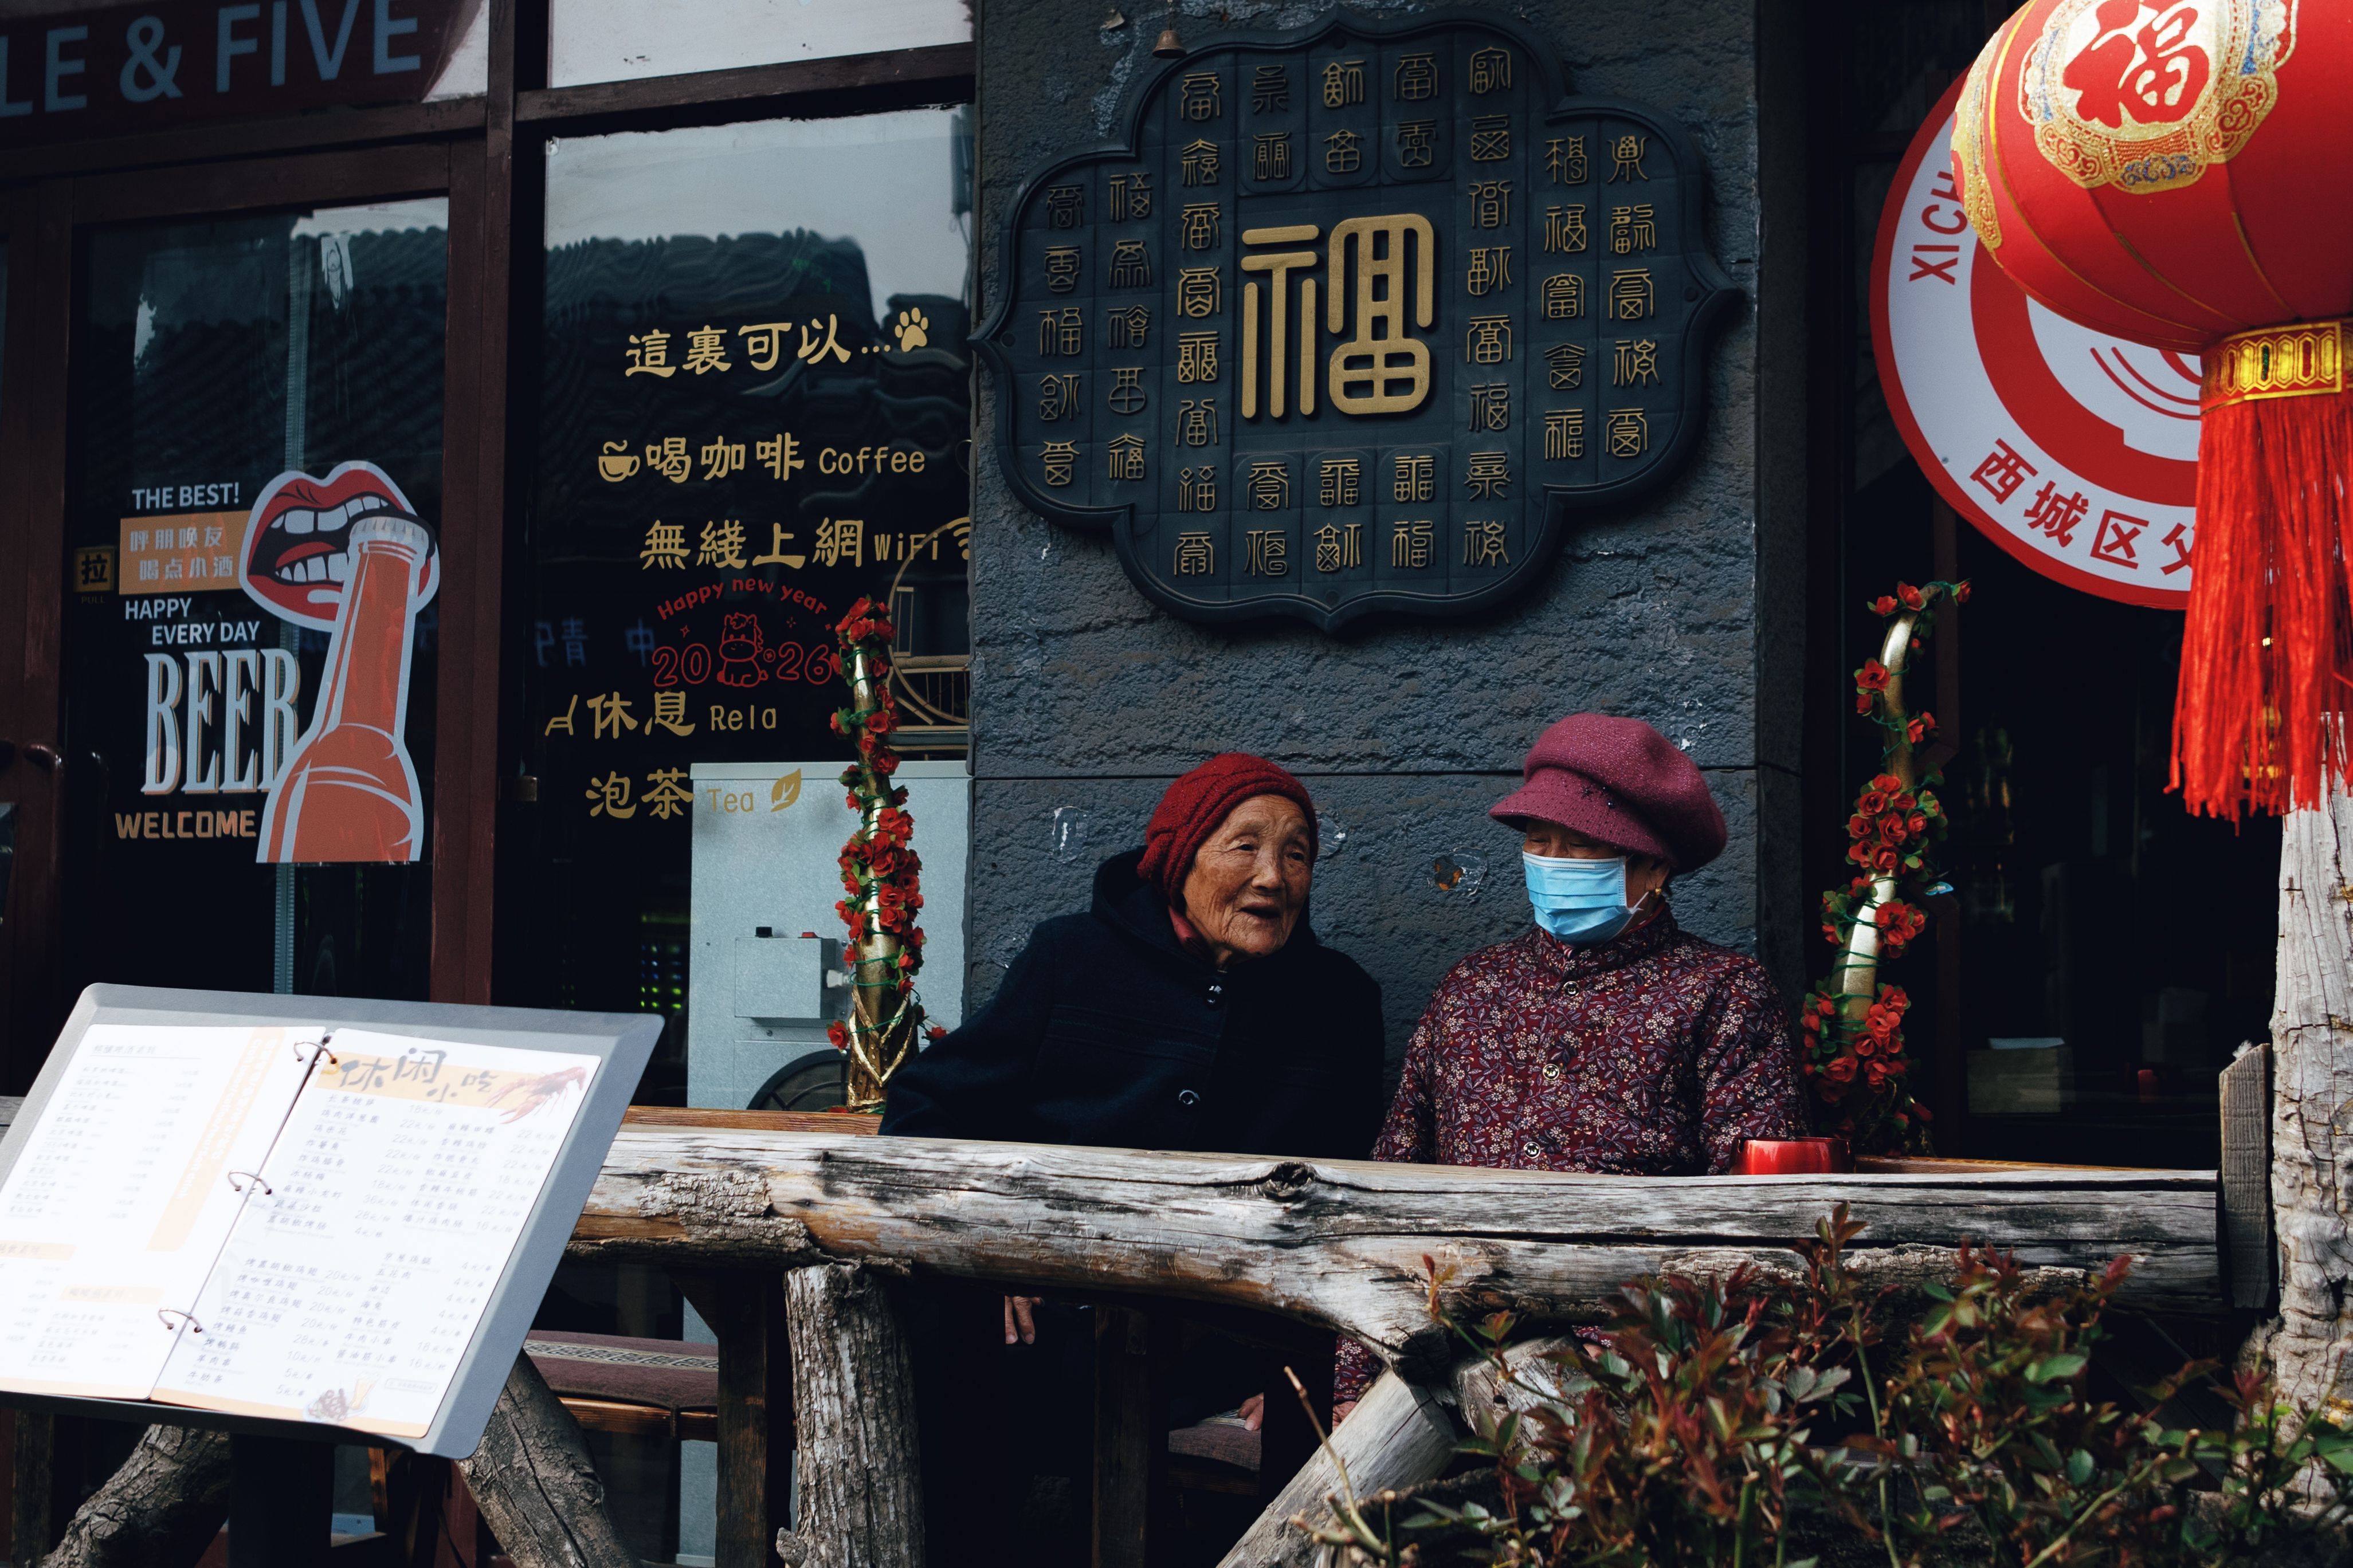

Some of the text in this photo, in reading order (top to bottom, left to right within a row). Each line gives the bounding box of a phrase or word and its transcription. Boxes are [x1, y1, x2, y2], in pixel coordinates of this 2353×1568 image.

[120, 15, 183, 102] &
[217, 0, 420, 93] FIVE
[1241, 213, 1435, 419] 福
[646, 433, 925, 484] 喝咖啡 Coffee
[132, 482, 240, 509] THE BEST!
[874, 532, 939, 561] WiFi
[81, 554, 108, 585] 拉
[139, 556, 233, 581] 喝点小酒
[81, 595, 106, 605] PULL
[125, 598, 192, 620] HAPPY
[657, 578, 828, 620] Happy new year
[151, 620, 260, 645] EVERY DAY
[140, 647, 300, 795] BEER
[587, 691, 777, 739] 休息 Rela
[586, 767, 754, 820] 泡茶 Tea
[115, 810, 257, 839] WELCOME
[339, 1047, 499, 1103] 休闲小吃
